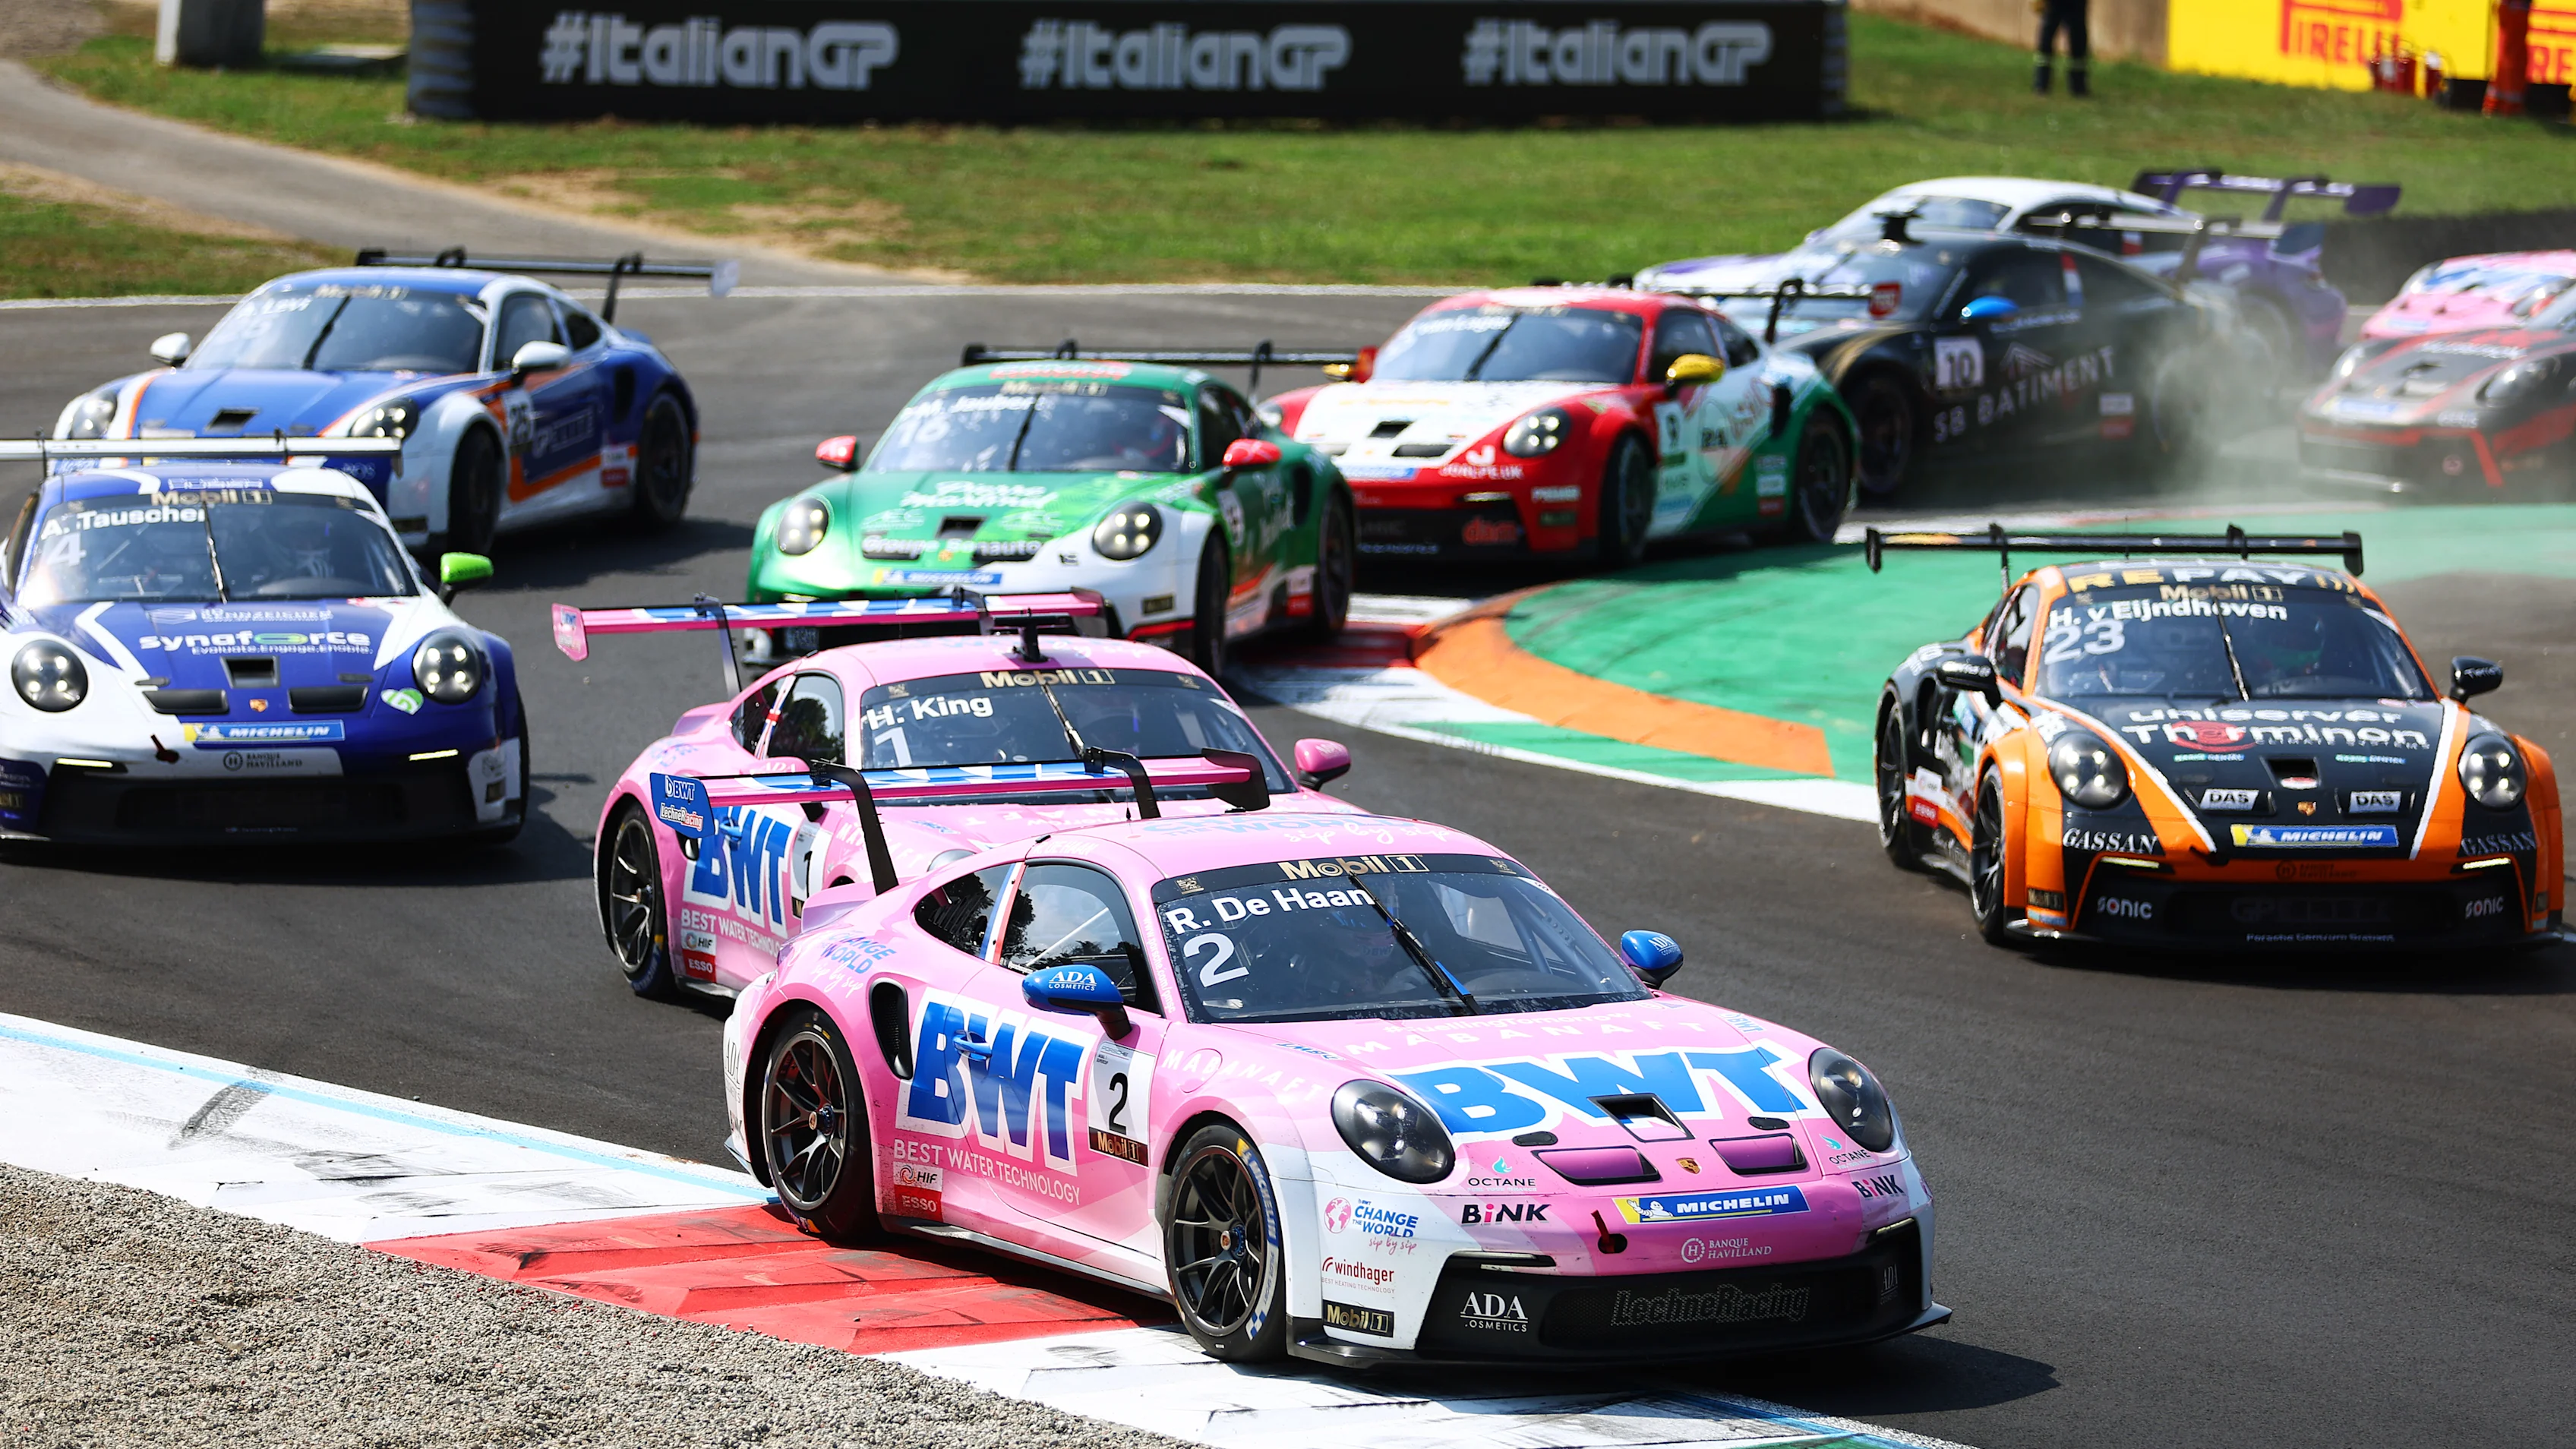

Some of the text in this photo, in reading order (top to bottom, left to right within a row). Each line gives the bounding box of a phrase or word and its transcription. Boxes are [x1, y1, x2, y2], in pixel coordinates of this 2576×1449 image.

[541, 11, 899, 90] #ItalianGP
[1018, 18, 1353, 91] #ItalianGP
[1461, 18, 1773, 86] #ItalianGP
[152, 488, 238, 506] Mobil
[41, 518, 70, 541] A.
[43, 532, 87, 567] 4
[2159, 585, 2249, 602] Mobil
[2049, 608, 2082, 630] H.
[2043, 618, 2125, 665] 23
[978, 669, 1078, 690] Mobil
[866, 696, 994, 731] H. King
[229, 726, 330, 738] MICHELIN
[874, 726, 912, 768] 1
[673, 781, 696, 801] BWT
[2208, 793, 2249, 804] DAS
[2357, 794, 2395, 807] DAS
[2062, 827, 2159, 855] GASSAN
[2281, 830, 2383, 842] MICHELIN
[2460, 831, 2536, 856] GASSAN
[690, 805, 793, 927] BWT
[803, 850, 813, 898] 1
[1277, 857, 1391, 880] Mobil
[1165, 887, 1375, 935] R. De Haan
[681, 908, 717, 933] BEST
[718, 916, 747, 945] WATER
[697, 938, 713, 949] HIF
[1648, 935, 1675, 951] ADA
[688, 958, 714, 974] ESSO
[1182, 933, 1250, 987] 2
[1049, 971, 1097, 983] ADA
[1728, 1017, 1765, 1033] BWT
[1346, 1021, 1707, 1056] MABANAFT
[1101, 1045, 1129, 1057] PORSCHE
[907, 1000, 1085, 1163] BWT
[1162, 1048, 1326, 1102] MABANAFT
[1384, 1046, 1809, 1135] BWT
[1109, 1072, 1129, 1135] 2
[1097, 1131, 1129, 1160] Mobil
[1829, 1148, 1871, 1165] OCTANE
[893, 1138, 1081, 1206] BEST WATER TECHNOLOGY
[916, 1170, 939, 1185] HIF
[1468, 1177, 1536, 1186] OCTANE
[901, 1195, 938, 1214] ESSO
[1250, 1160, 1277, 1239] MICHELIN
[1676, 1193, 1790, 1214] MICHELIN
[1354, 1205, 1419, 1229] CHANGE
[1362, 1220, 1414, 1238] WORLD
[1368, 1237, 1383, 1252] sip
[1400, 1239, 1418, 1255] sip
[1708, 1245, 1773, 1260] HAVILLAND
[1709, 1237, 1749, 1249] BANQUE
[1334, 1258, 1395, 1285] windhager
[1881, 1262, 1899, 1290] ADA
[1334, 1280, 1356, 1290] HEATING
[1358, 1283, 1395, 1294] TECHNOLOGY
[1460, 1291, 1529, 1320] ADA
[1327, 1304, 1369, 1331] Mobil
[1464, 1320, 1528, 1334] OSMETICS
